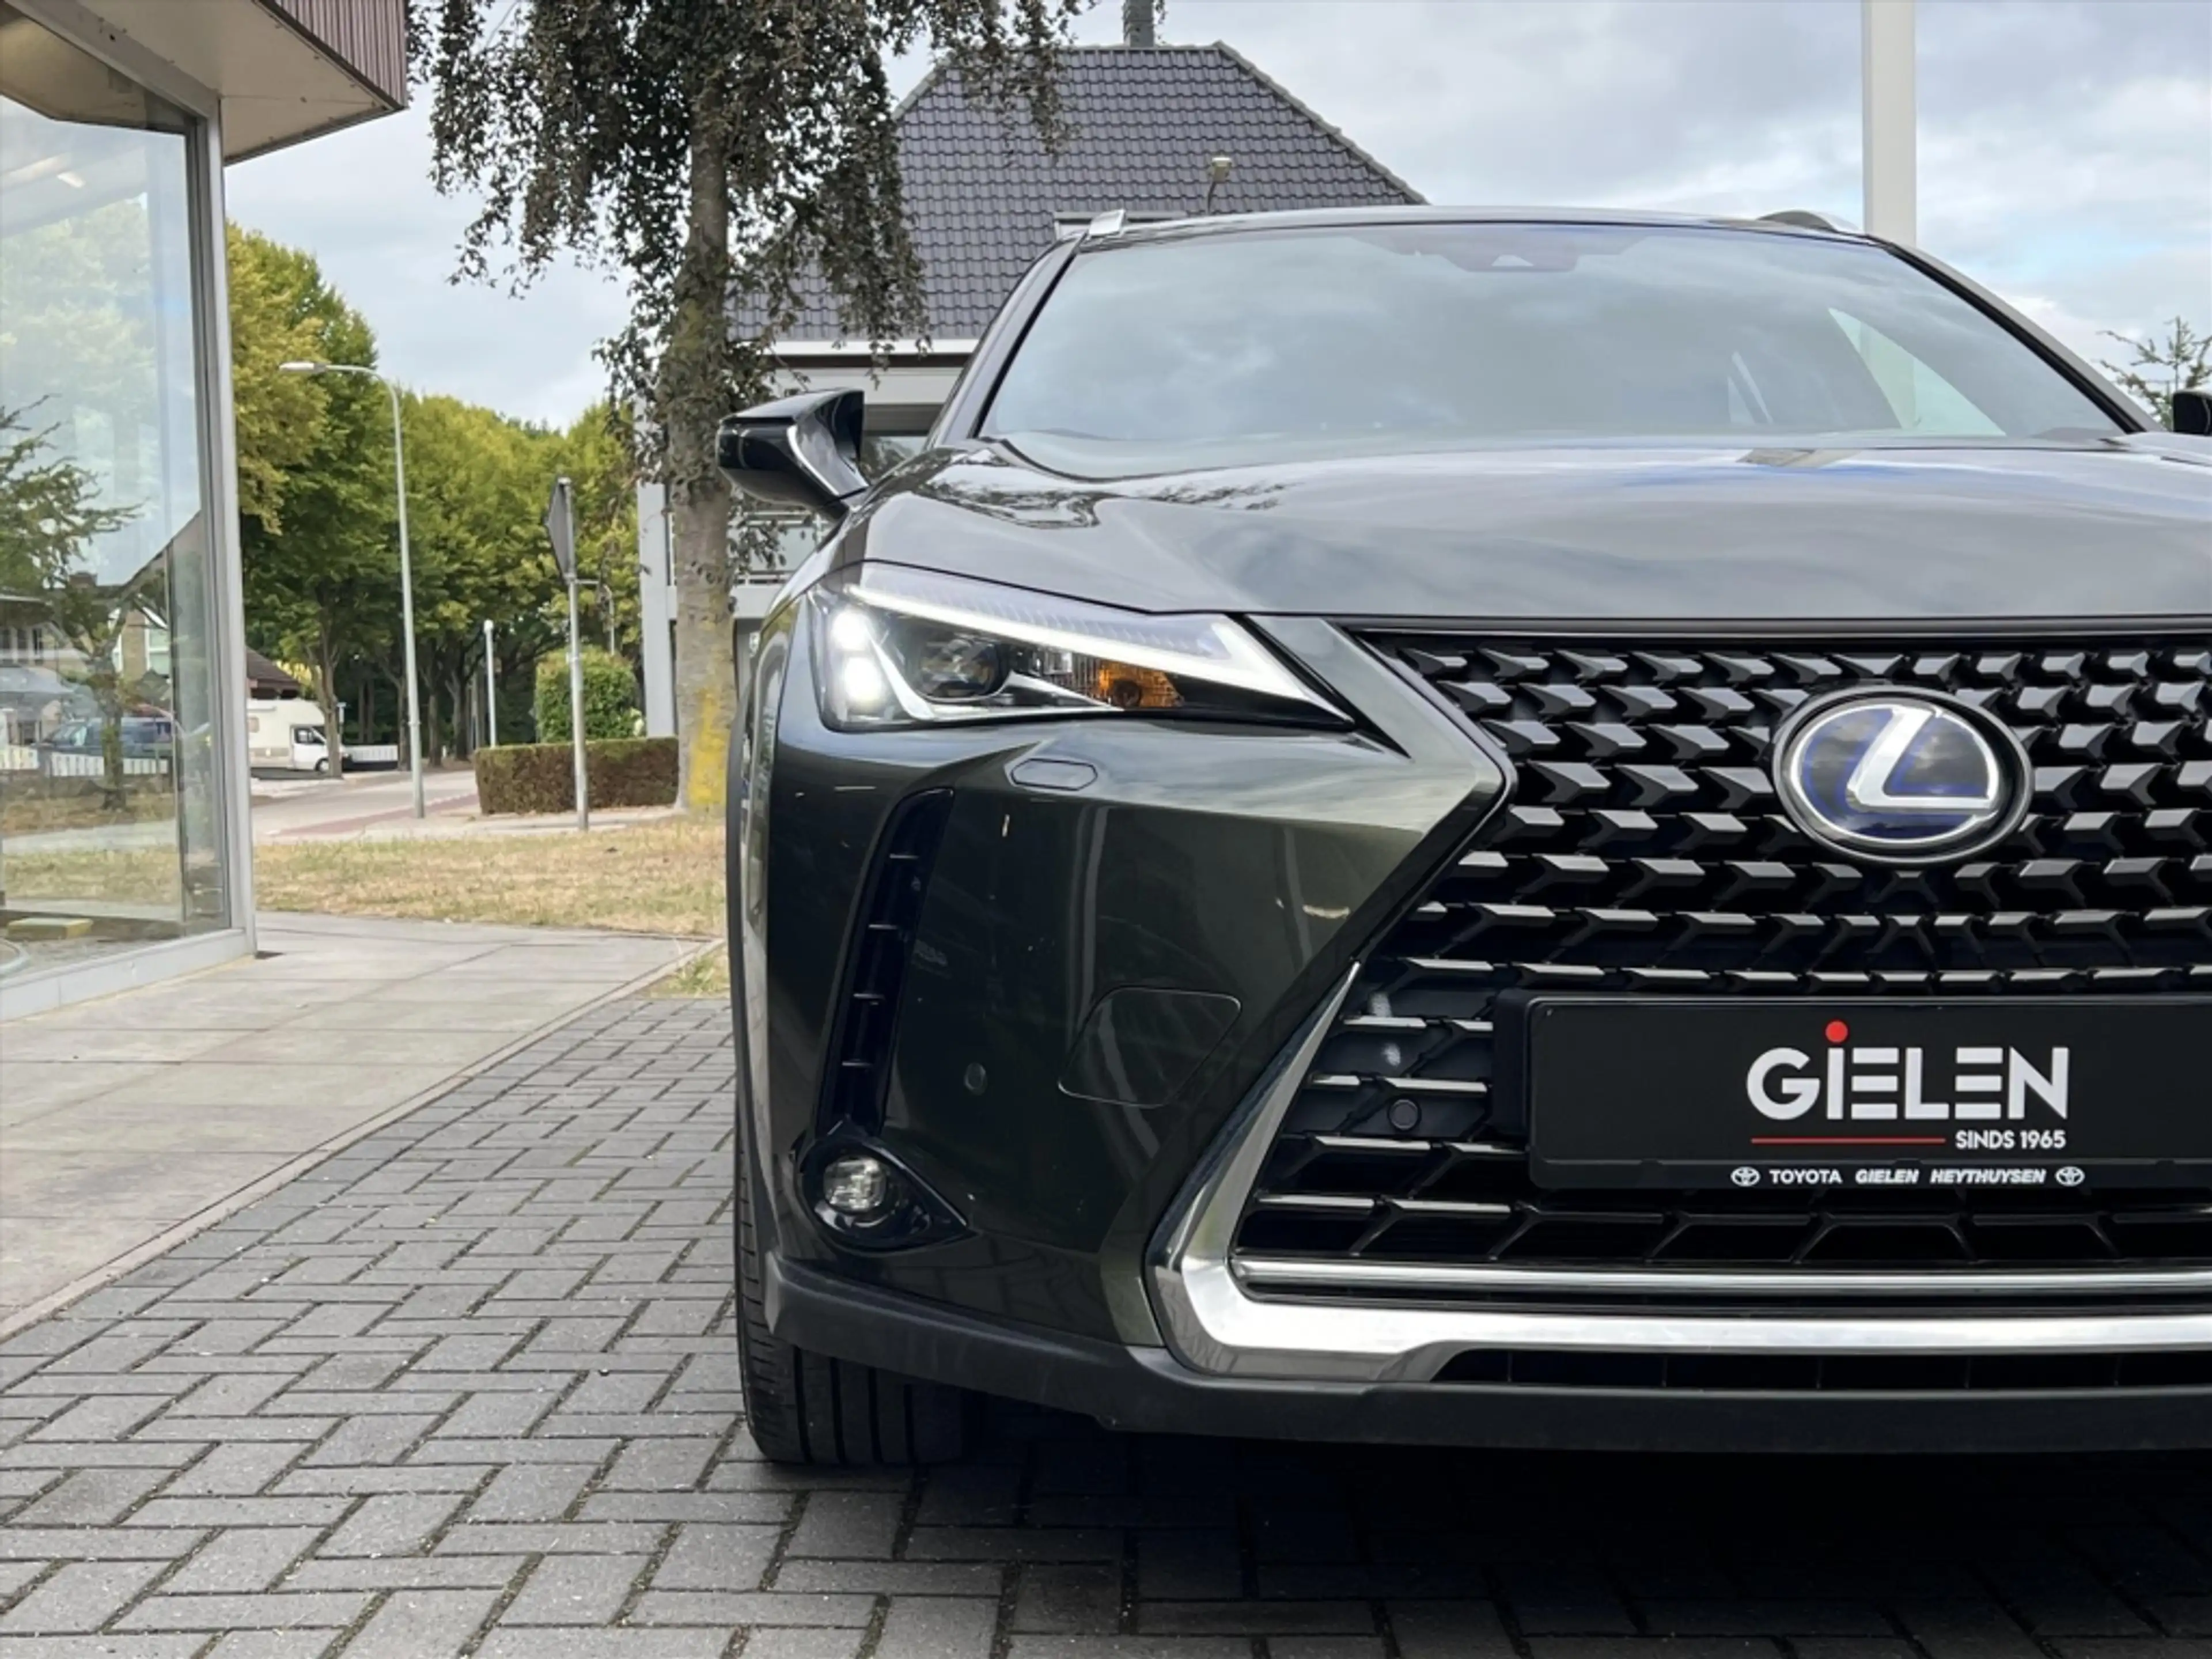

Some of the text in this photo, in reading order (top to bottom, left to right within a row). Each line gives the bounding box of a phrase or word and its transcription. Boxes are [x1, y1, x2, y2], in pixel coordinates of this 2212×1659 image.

[1746, 1020, 2069, 1120] GIELEN
[1955, 1129, 2066, 1150] SINDS 1965
[1768, 1167, 2047, 1185] TOYOTA GIELEN HEYTHUYSEN
